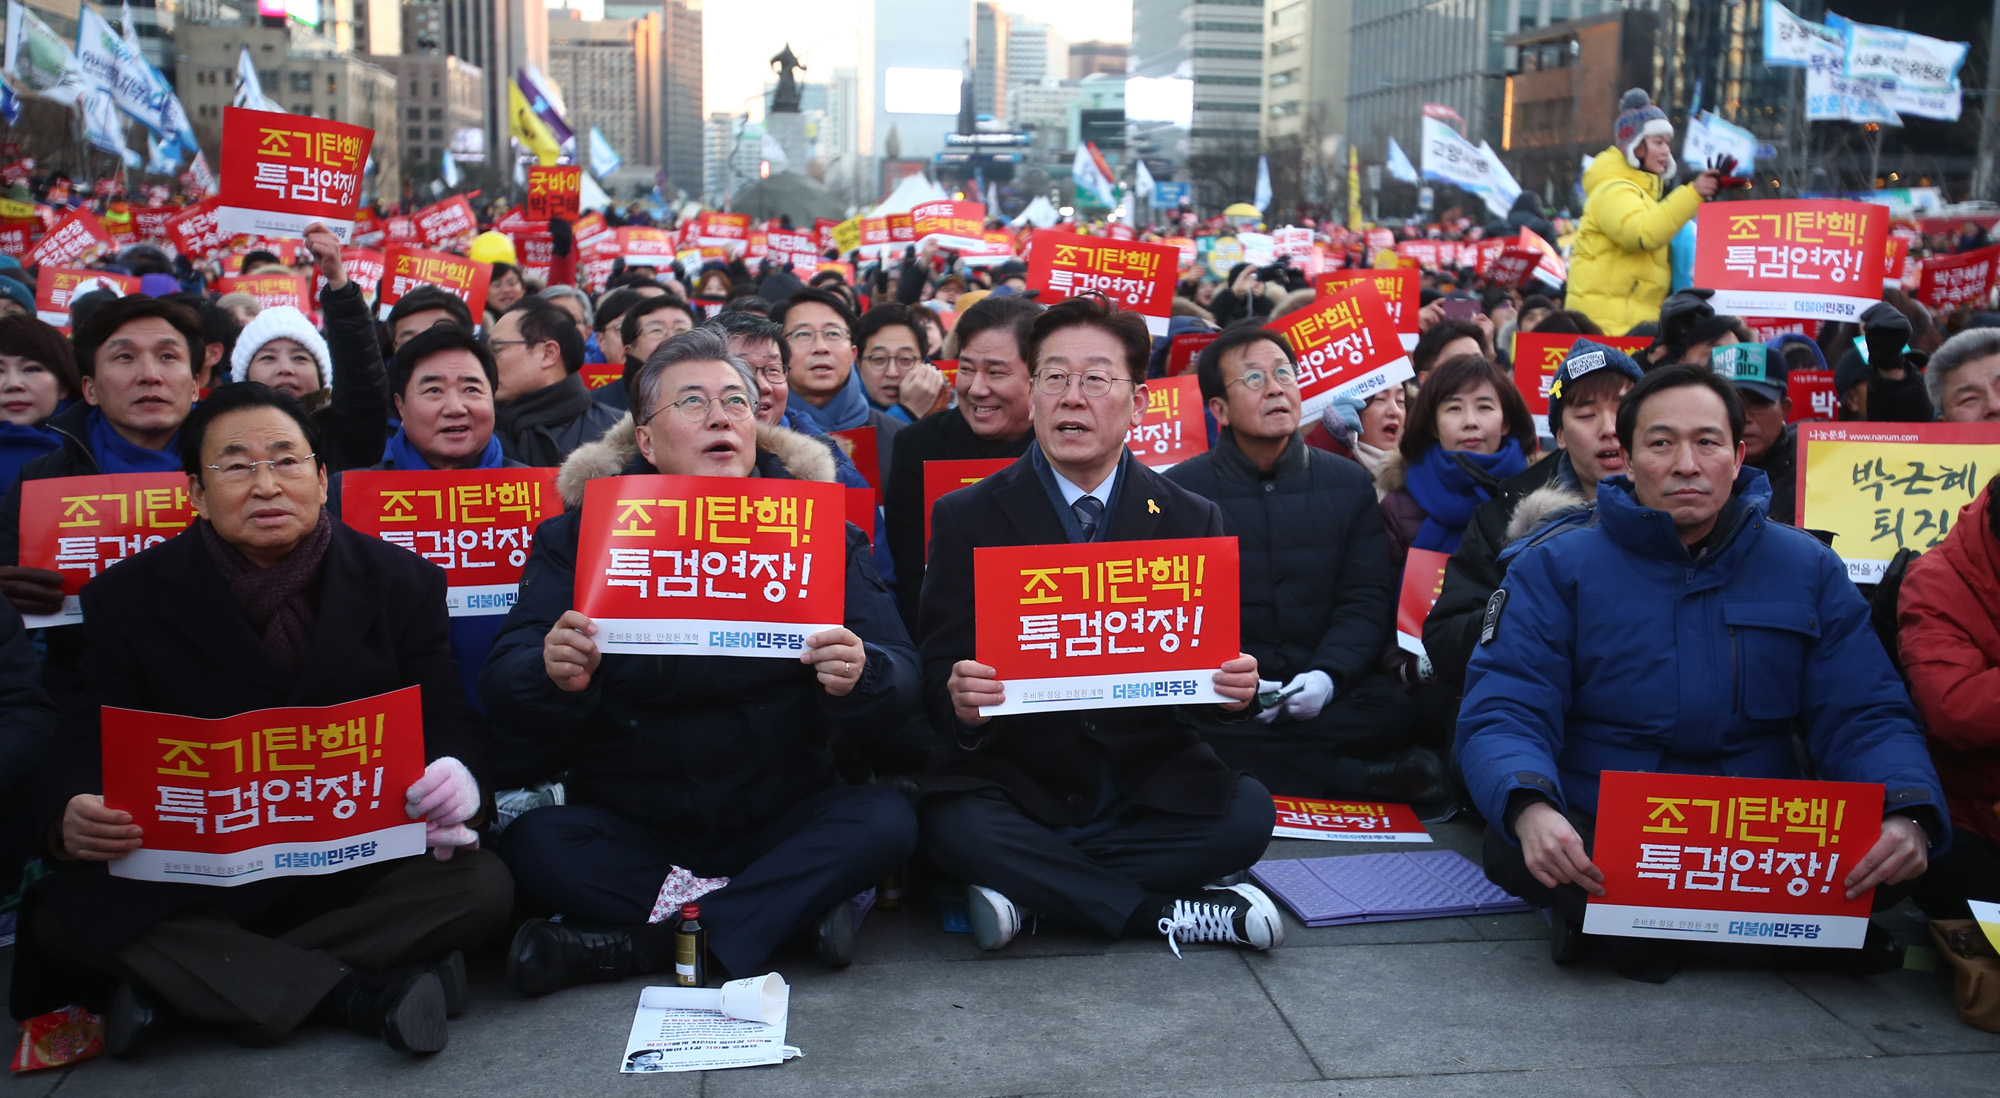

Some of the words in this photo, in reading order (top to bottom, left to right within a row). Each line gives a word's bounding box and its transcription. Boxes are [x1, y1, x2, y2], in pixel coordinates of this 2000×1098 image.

[257, 127, 363, 171] 조기탄핵!
[253, 161, 356, 207] 특검연장!
[529, 171, 580, 196] 굿바이
[1727, 210, 1868, 247] 조기탄핵!
[394, 253, 476, 289] 조기탄핵!
[1052, 243, 1160, 279] 조기탄핵!
[1724, 245, 1864, 283] 특검연장!
[1048, 269, 1155, 305] 특검연장!
[1794, 300, 1856, 316] 더불어민주당
[1332, 373, 1387, 401] 어민주당
[1809, 429, 1847, 440] 나눔문화
[1850, 433, 1919, 442] www.nanum.com
[1852, 456, 1977, 502] 박근혜
[58, 486, 200, 528] 조기탄
[379, 481, 541, 524] 조기탄핵!
[611, 495, 815, 548] 조기탄핵!
[605, 548, 813, 603] 특검연장!
[1019, 554, 1206, 605] 조기탄핵!
[608, 632, 632, 642] 준비된
[635, 632, 651, 642] 정당
[656, 632, 681, 642] 안정된
[683, 633, 699, 642] 개혁
[709, 631, 805, 650] 더불어민주당
[1017, 605, 1204, 660] 특검연장!
[1022, 691, 1045, 700] 준비된
[1046, 690, 1062, 699] 정당
[1065, 689, 1089, 699] 안정된
[1089, 687, 1104, 697] 개혁
[1112, 679, 1198, 700] 더불어민주당
[156, 713, 385, 778] 조기탄핵!
[154, 766, 385, 835] 특검연장!
[1642, 796, 1847, 848] 조기탄핵!
[164, 862, 191, 872] 준비된
[192, 864, 212, 874] 정당
[216, 863, 244, 875] 안정된
[247, 859, 264, 870] 개혁
[274, 840, 379, 869] 더불어민주당
[1635, 843, 1841, 897] 특검연장!
[1632, 917, 1656, 928] 준비된
[1658, 918, 1674, 928] 정당
[1678, 919, 1703, 930] 안정된
[1704, 921, 1720, 931] 개혁
[1728, 920, 1821, 940] 더불어민주당
